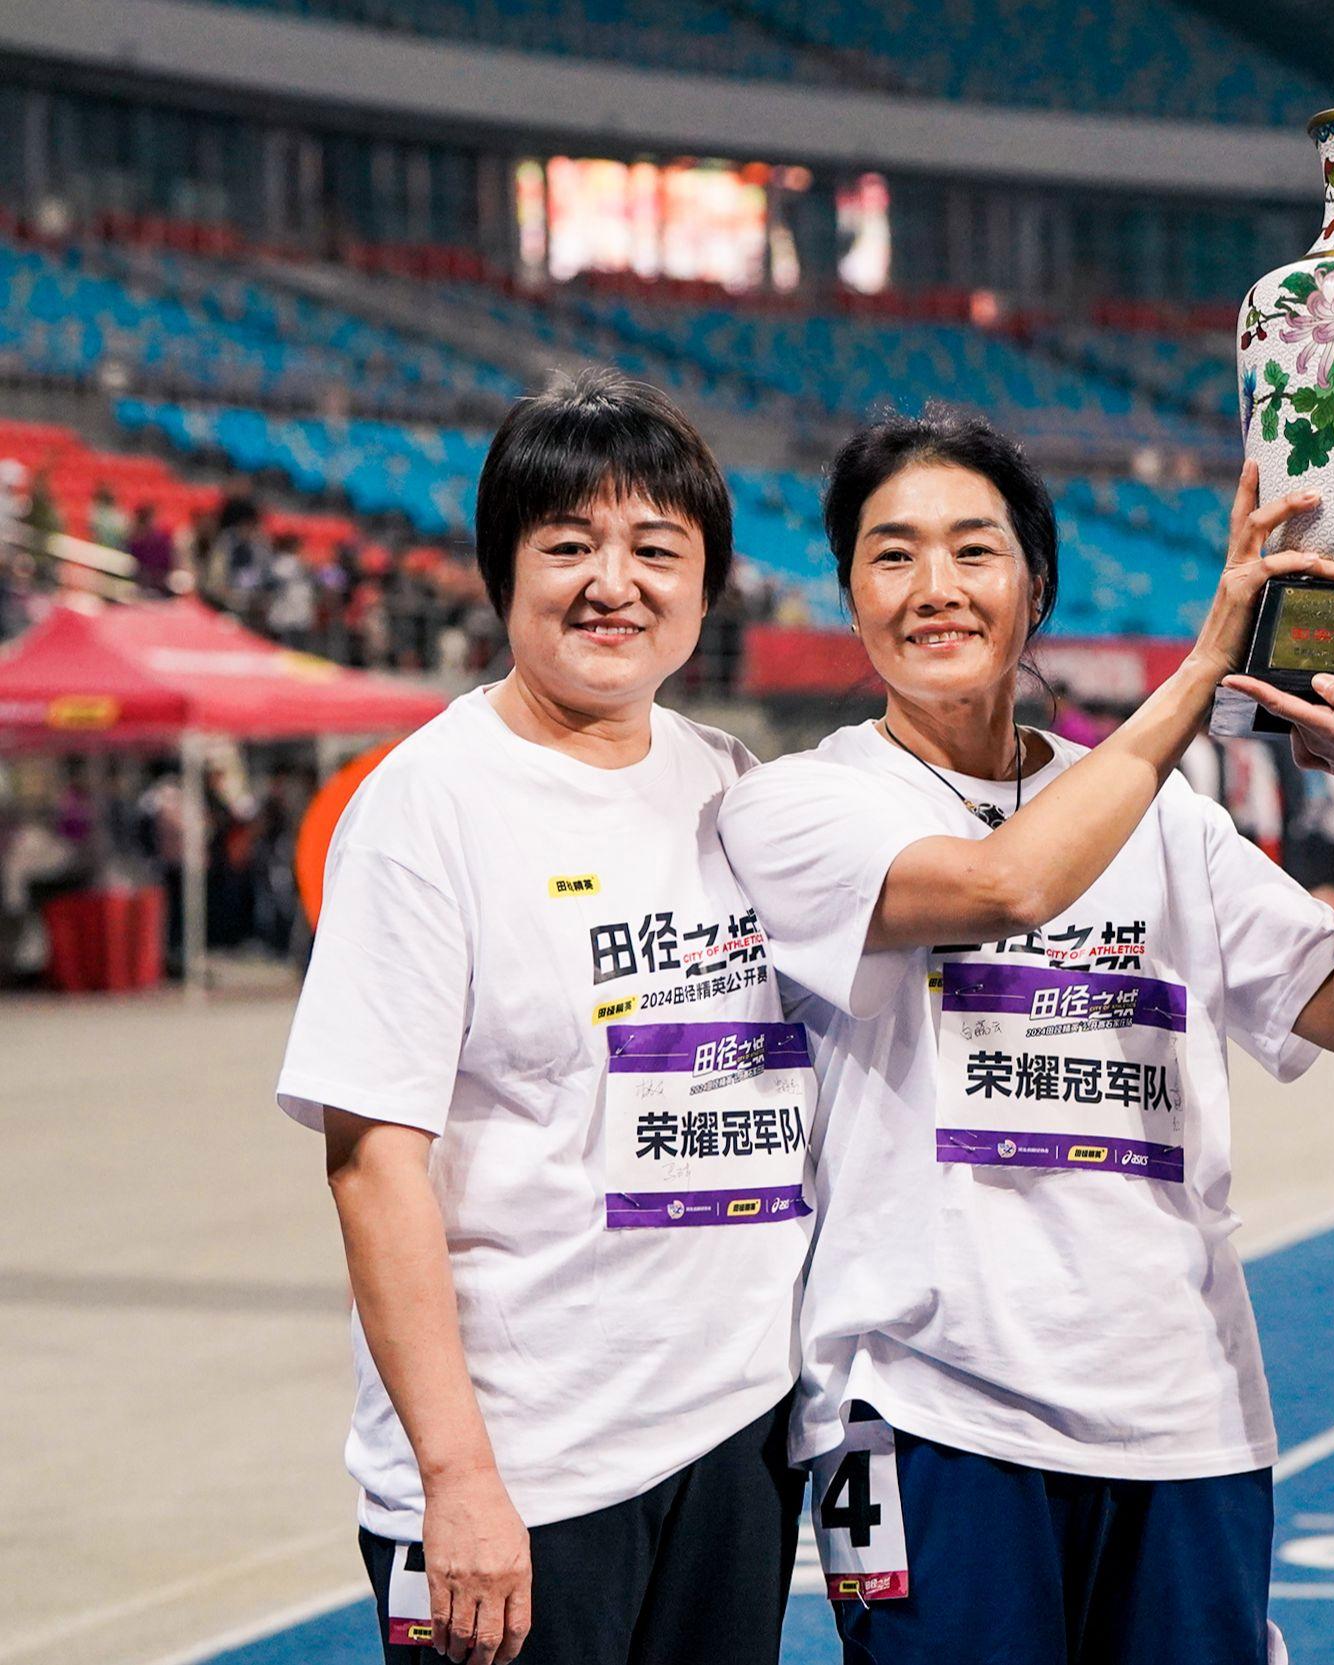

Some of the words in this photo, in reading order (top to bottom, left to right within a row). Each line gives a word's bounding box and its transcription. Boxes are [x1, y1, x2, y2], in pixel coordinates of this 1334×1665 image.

[590, 908, 767, 986] 田径之城
[683, 951, 703, 964] CITY
[706, 946, 719, 957] OF
[1046, 949, 1067, 960] CITY
[1089, 945, 1145, 956] ATHLETICS
[640, 964, 768, 1010] 2024田径精英公开赛
[1029, 984, 1139, 1020] 田径之城
[692, 1033, 766, 1078] 田径之城
[966, 1050, 1173, 1113] 荣耀冠军队
[635, 1106, 806, 1160] 荣耀冠军队
[821, 1450, 881, 1548] 4
